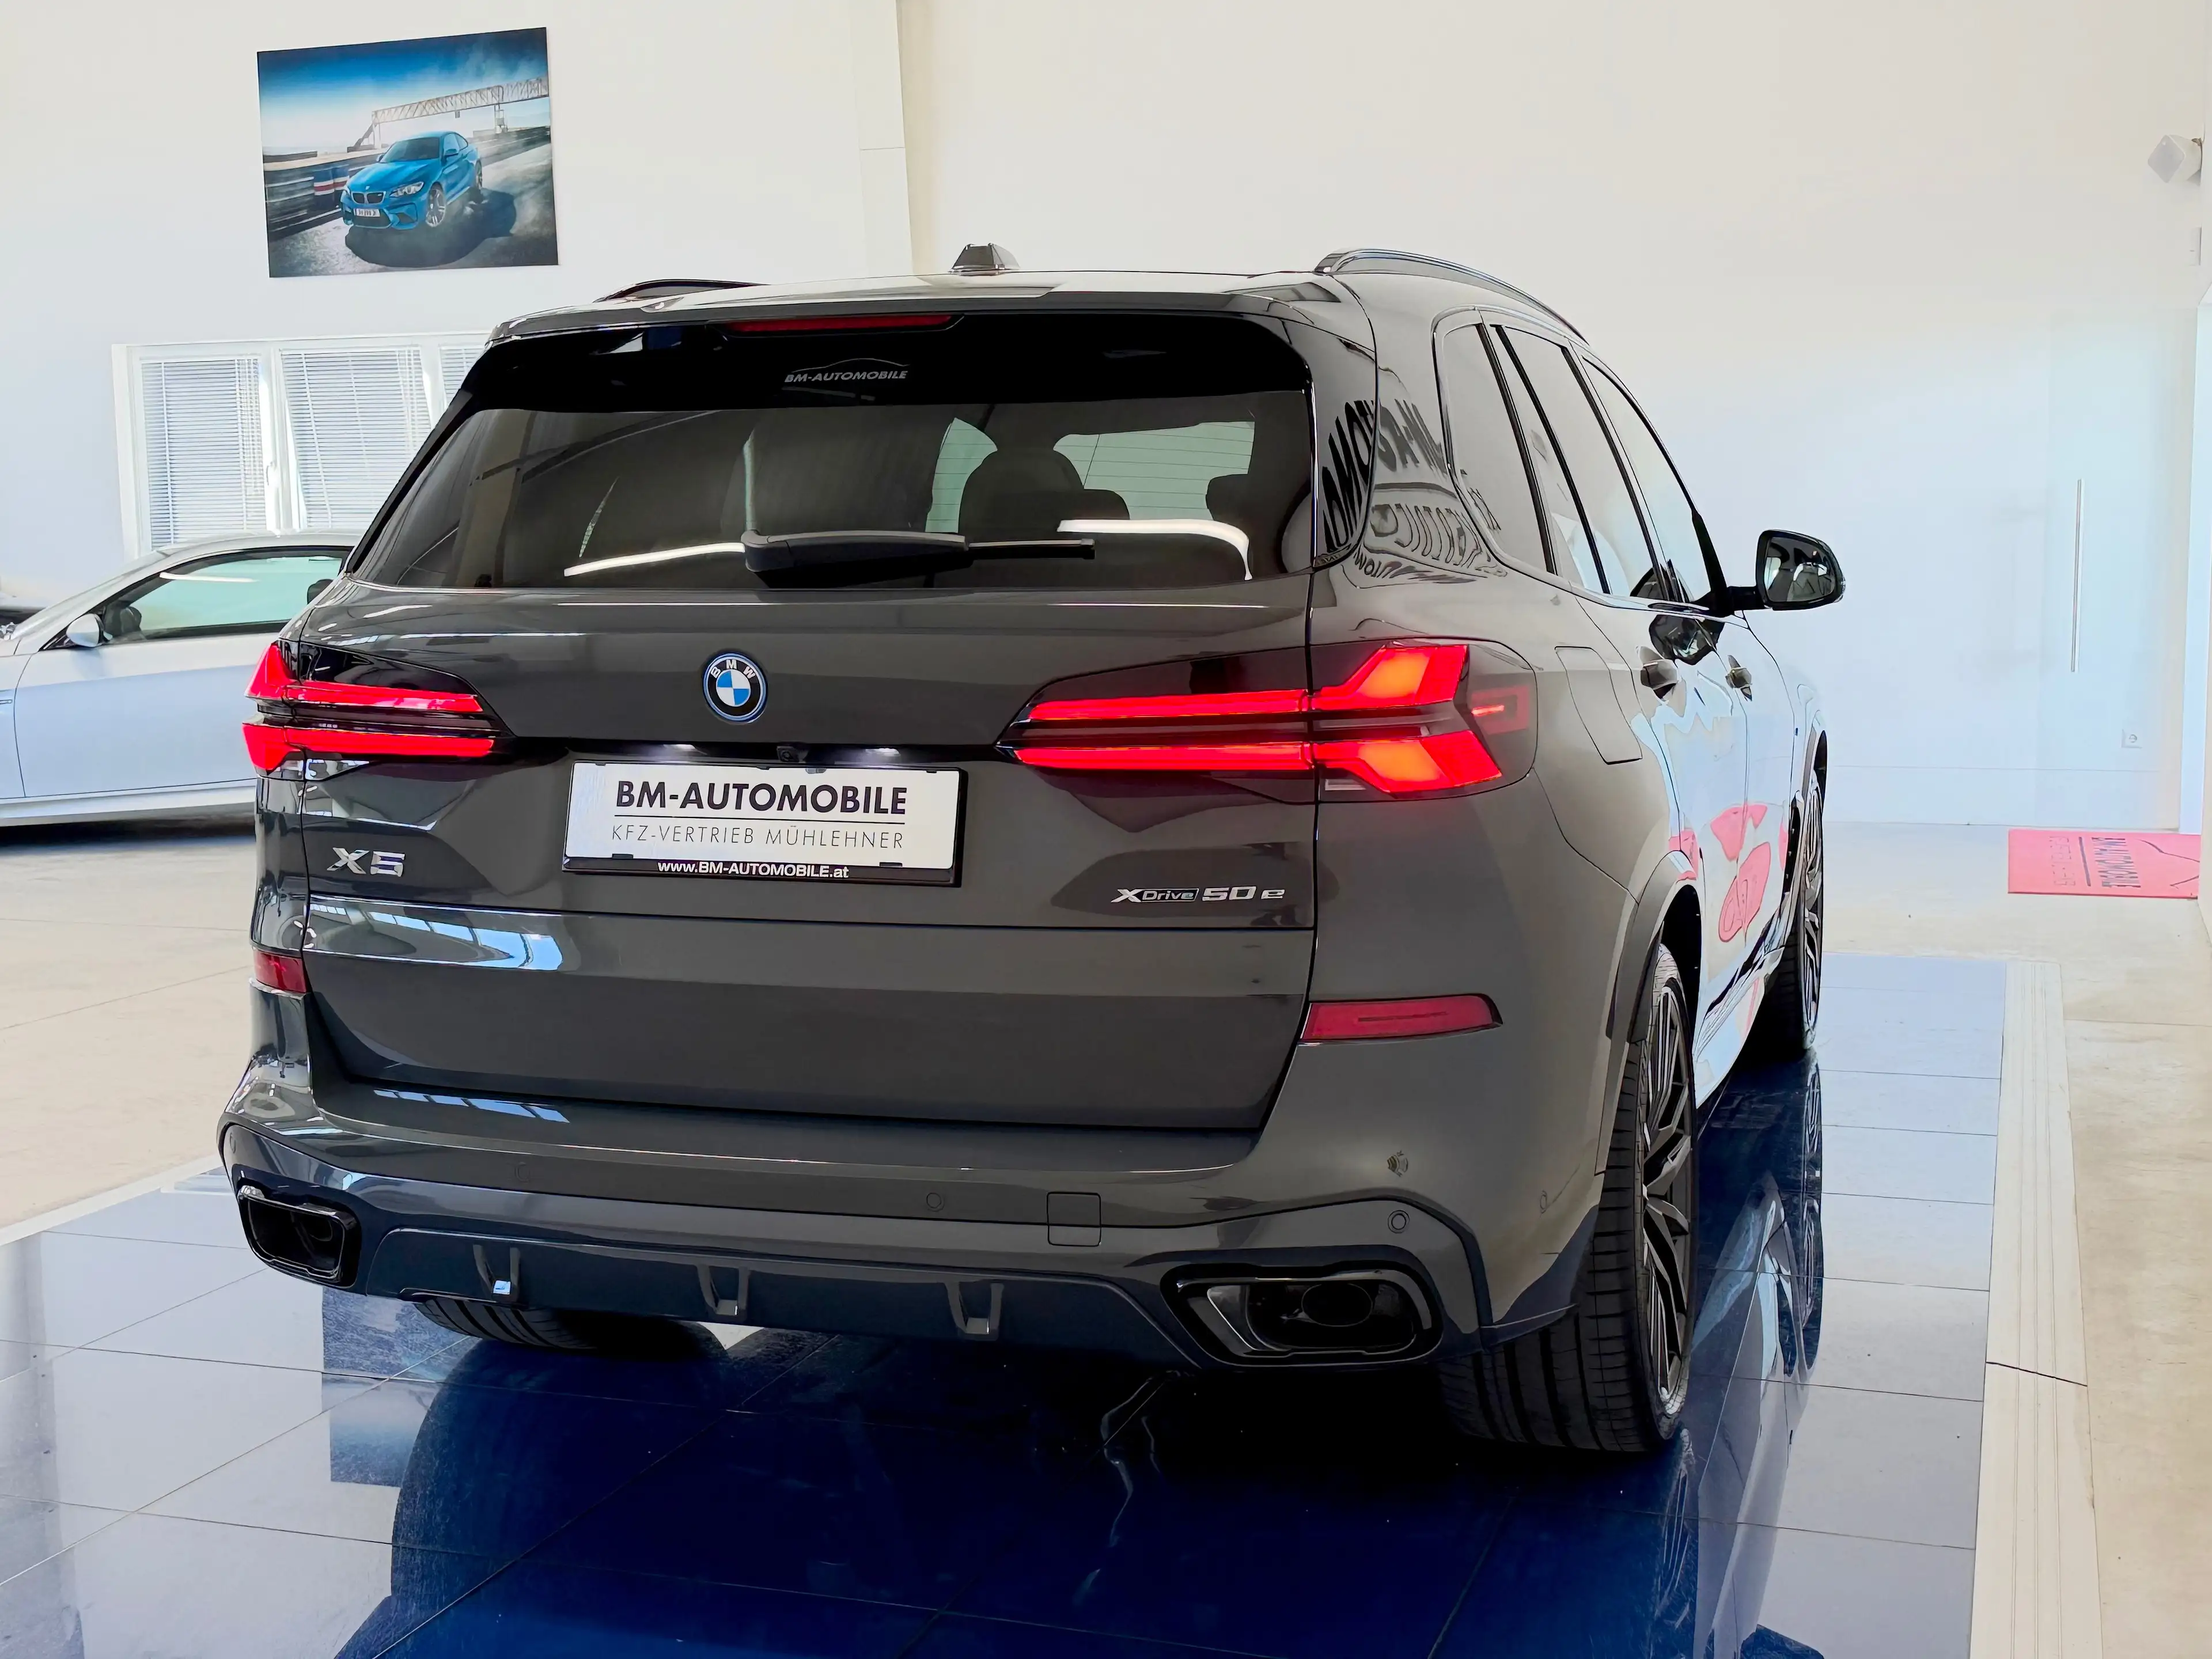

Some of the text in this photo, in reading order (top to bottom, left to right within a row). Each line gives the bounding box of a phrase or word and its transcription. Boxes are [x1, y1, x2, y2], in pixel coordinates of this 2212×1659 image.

[784, 370, 908, 382] BM-AUTOMOBILE
[710, 659, 756, 679] BMW
[616, 780, 907, 815] BM-AUTOMOBILE
[612, 824, 903, 848] KFZ-VERTRIEB MÜHLEHNER
[326, 847, 406, 877] X5
[657, 861, 849, 878] www.BM-AUTOMOBILE.at
